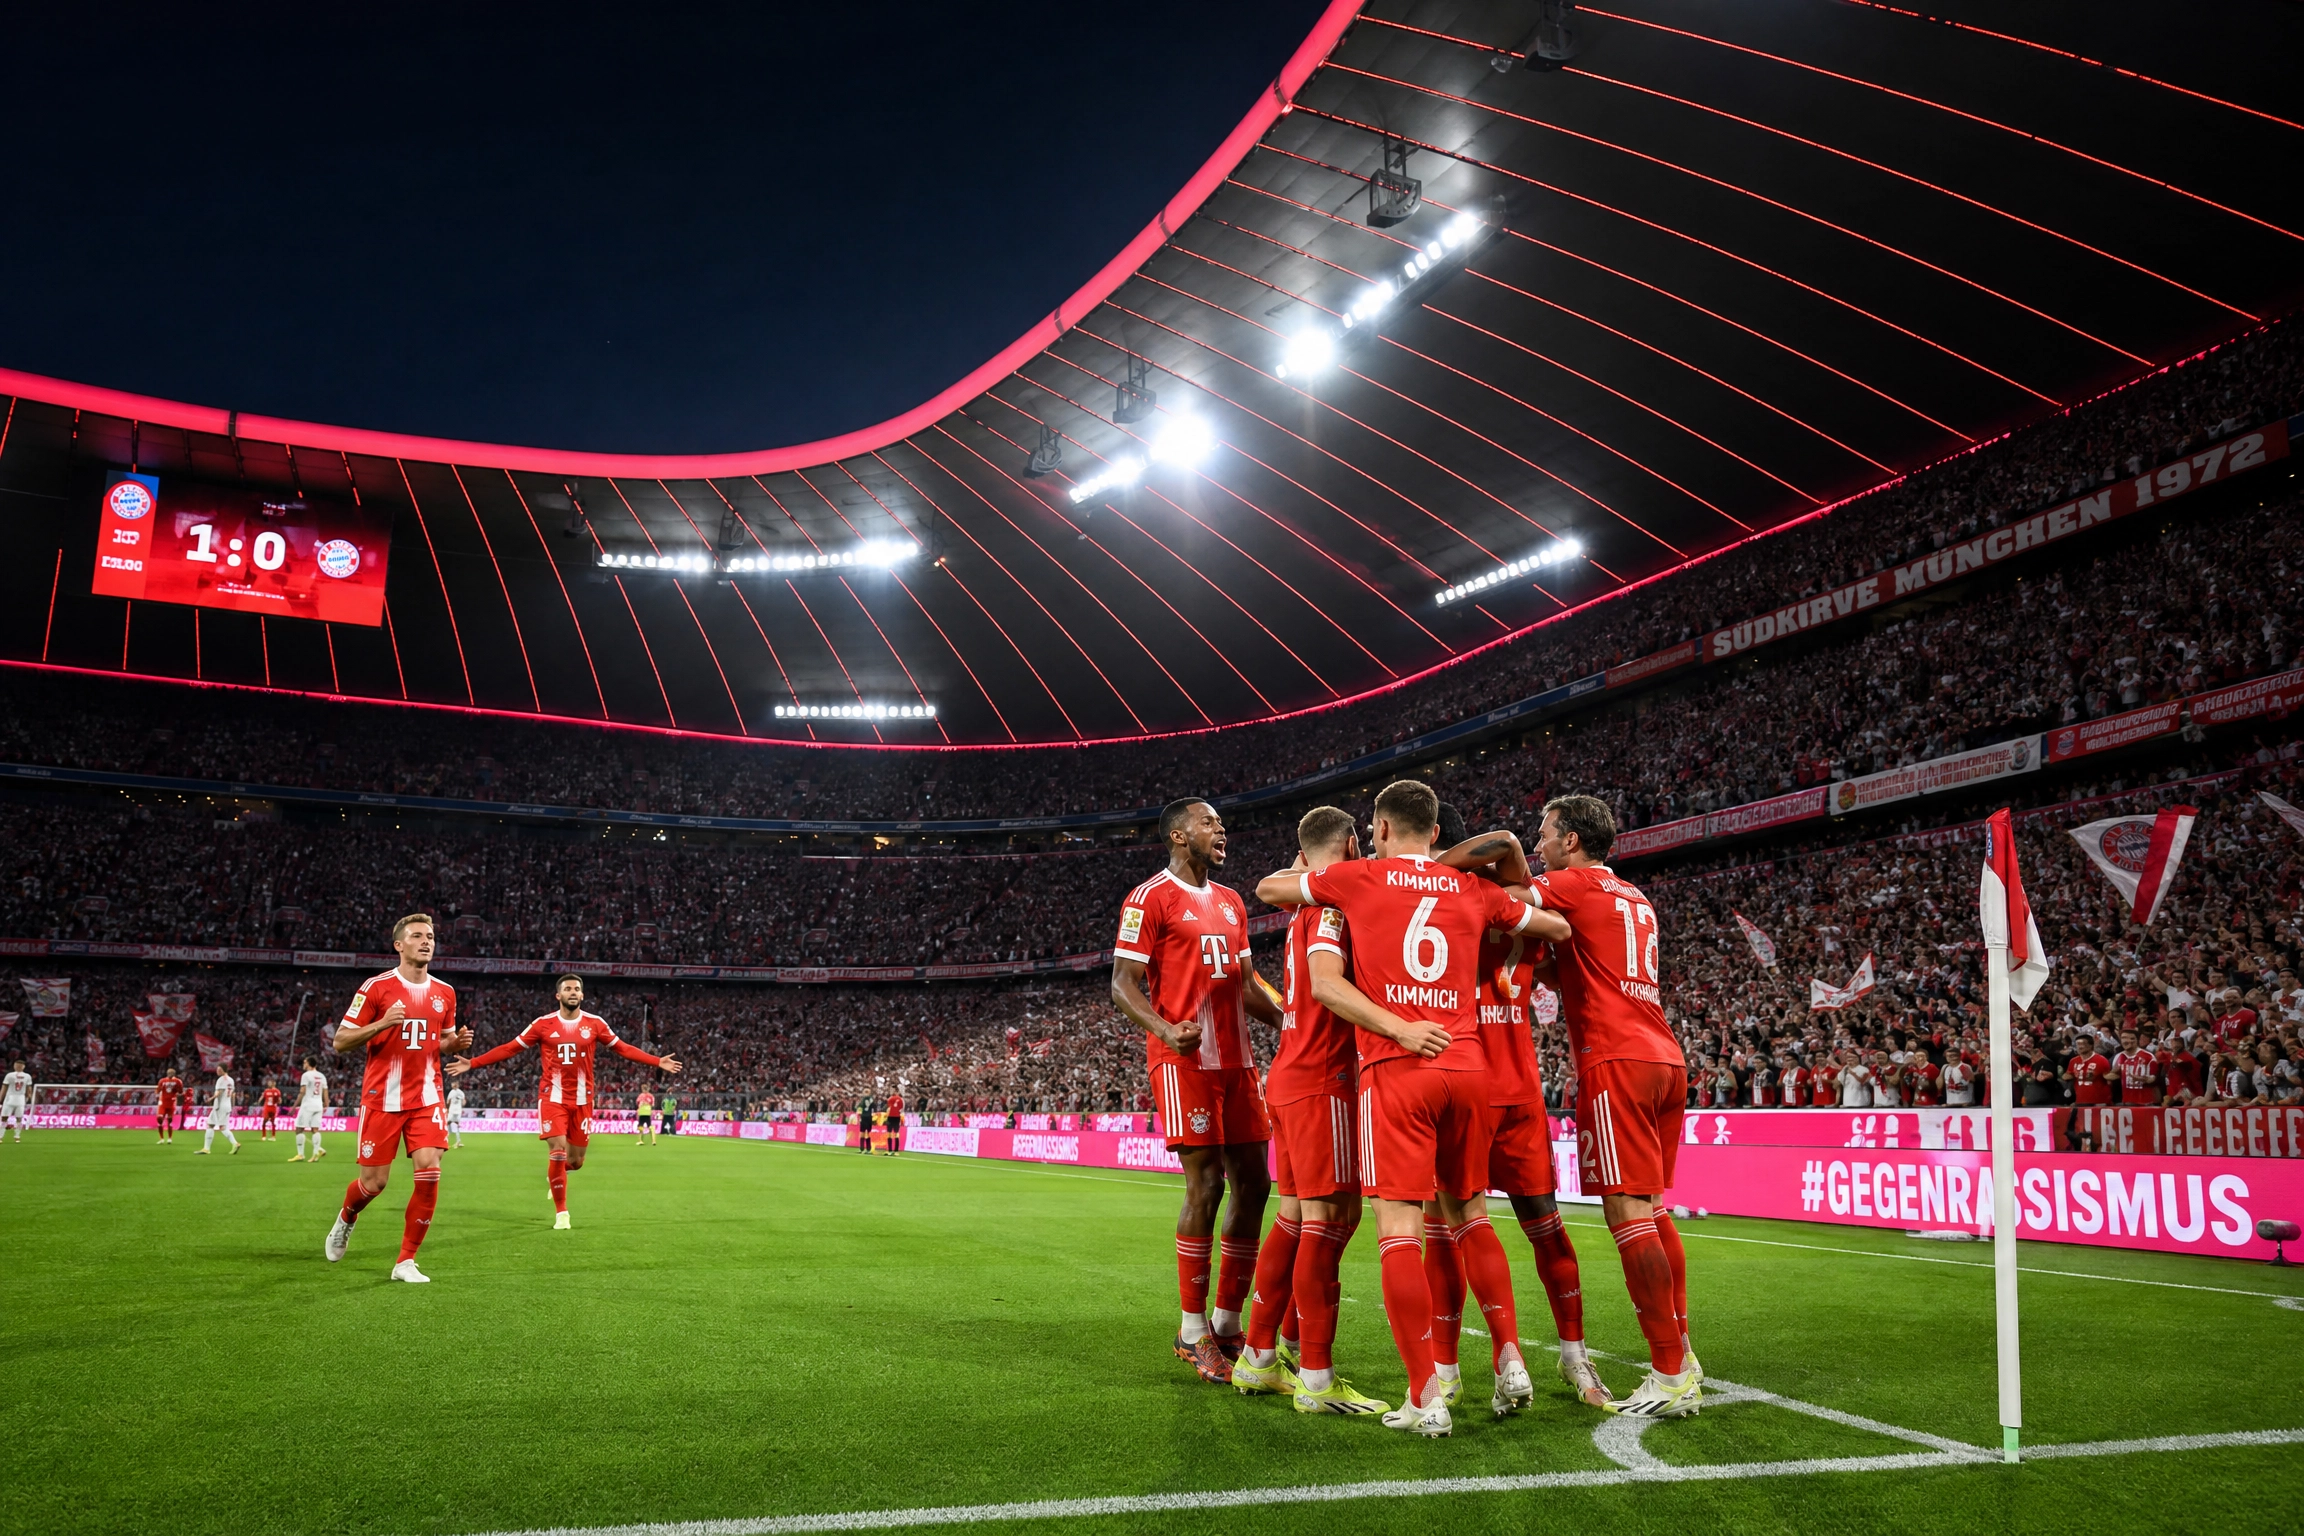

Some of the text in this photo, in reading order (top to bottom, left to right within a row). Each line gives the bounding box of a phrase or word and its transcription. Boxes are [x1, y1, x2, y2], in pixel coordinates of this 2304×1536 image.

[1894, 490, 2112, 596] MÜNCHEN
[2135, 433, 2266, 508] 1972
[186, 523, 286, 571] 1:0
[1387, 870, 1460, 893] KIMMICH
[1403, 896, 1449, 983] 6
[1385, 984, 1458, 1010] KIMMICH
